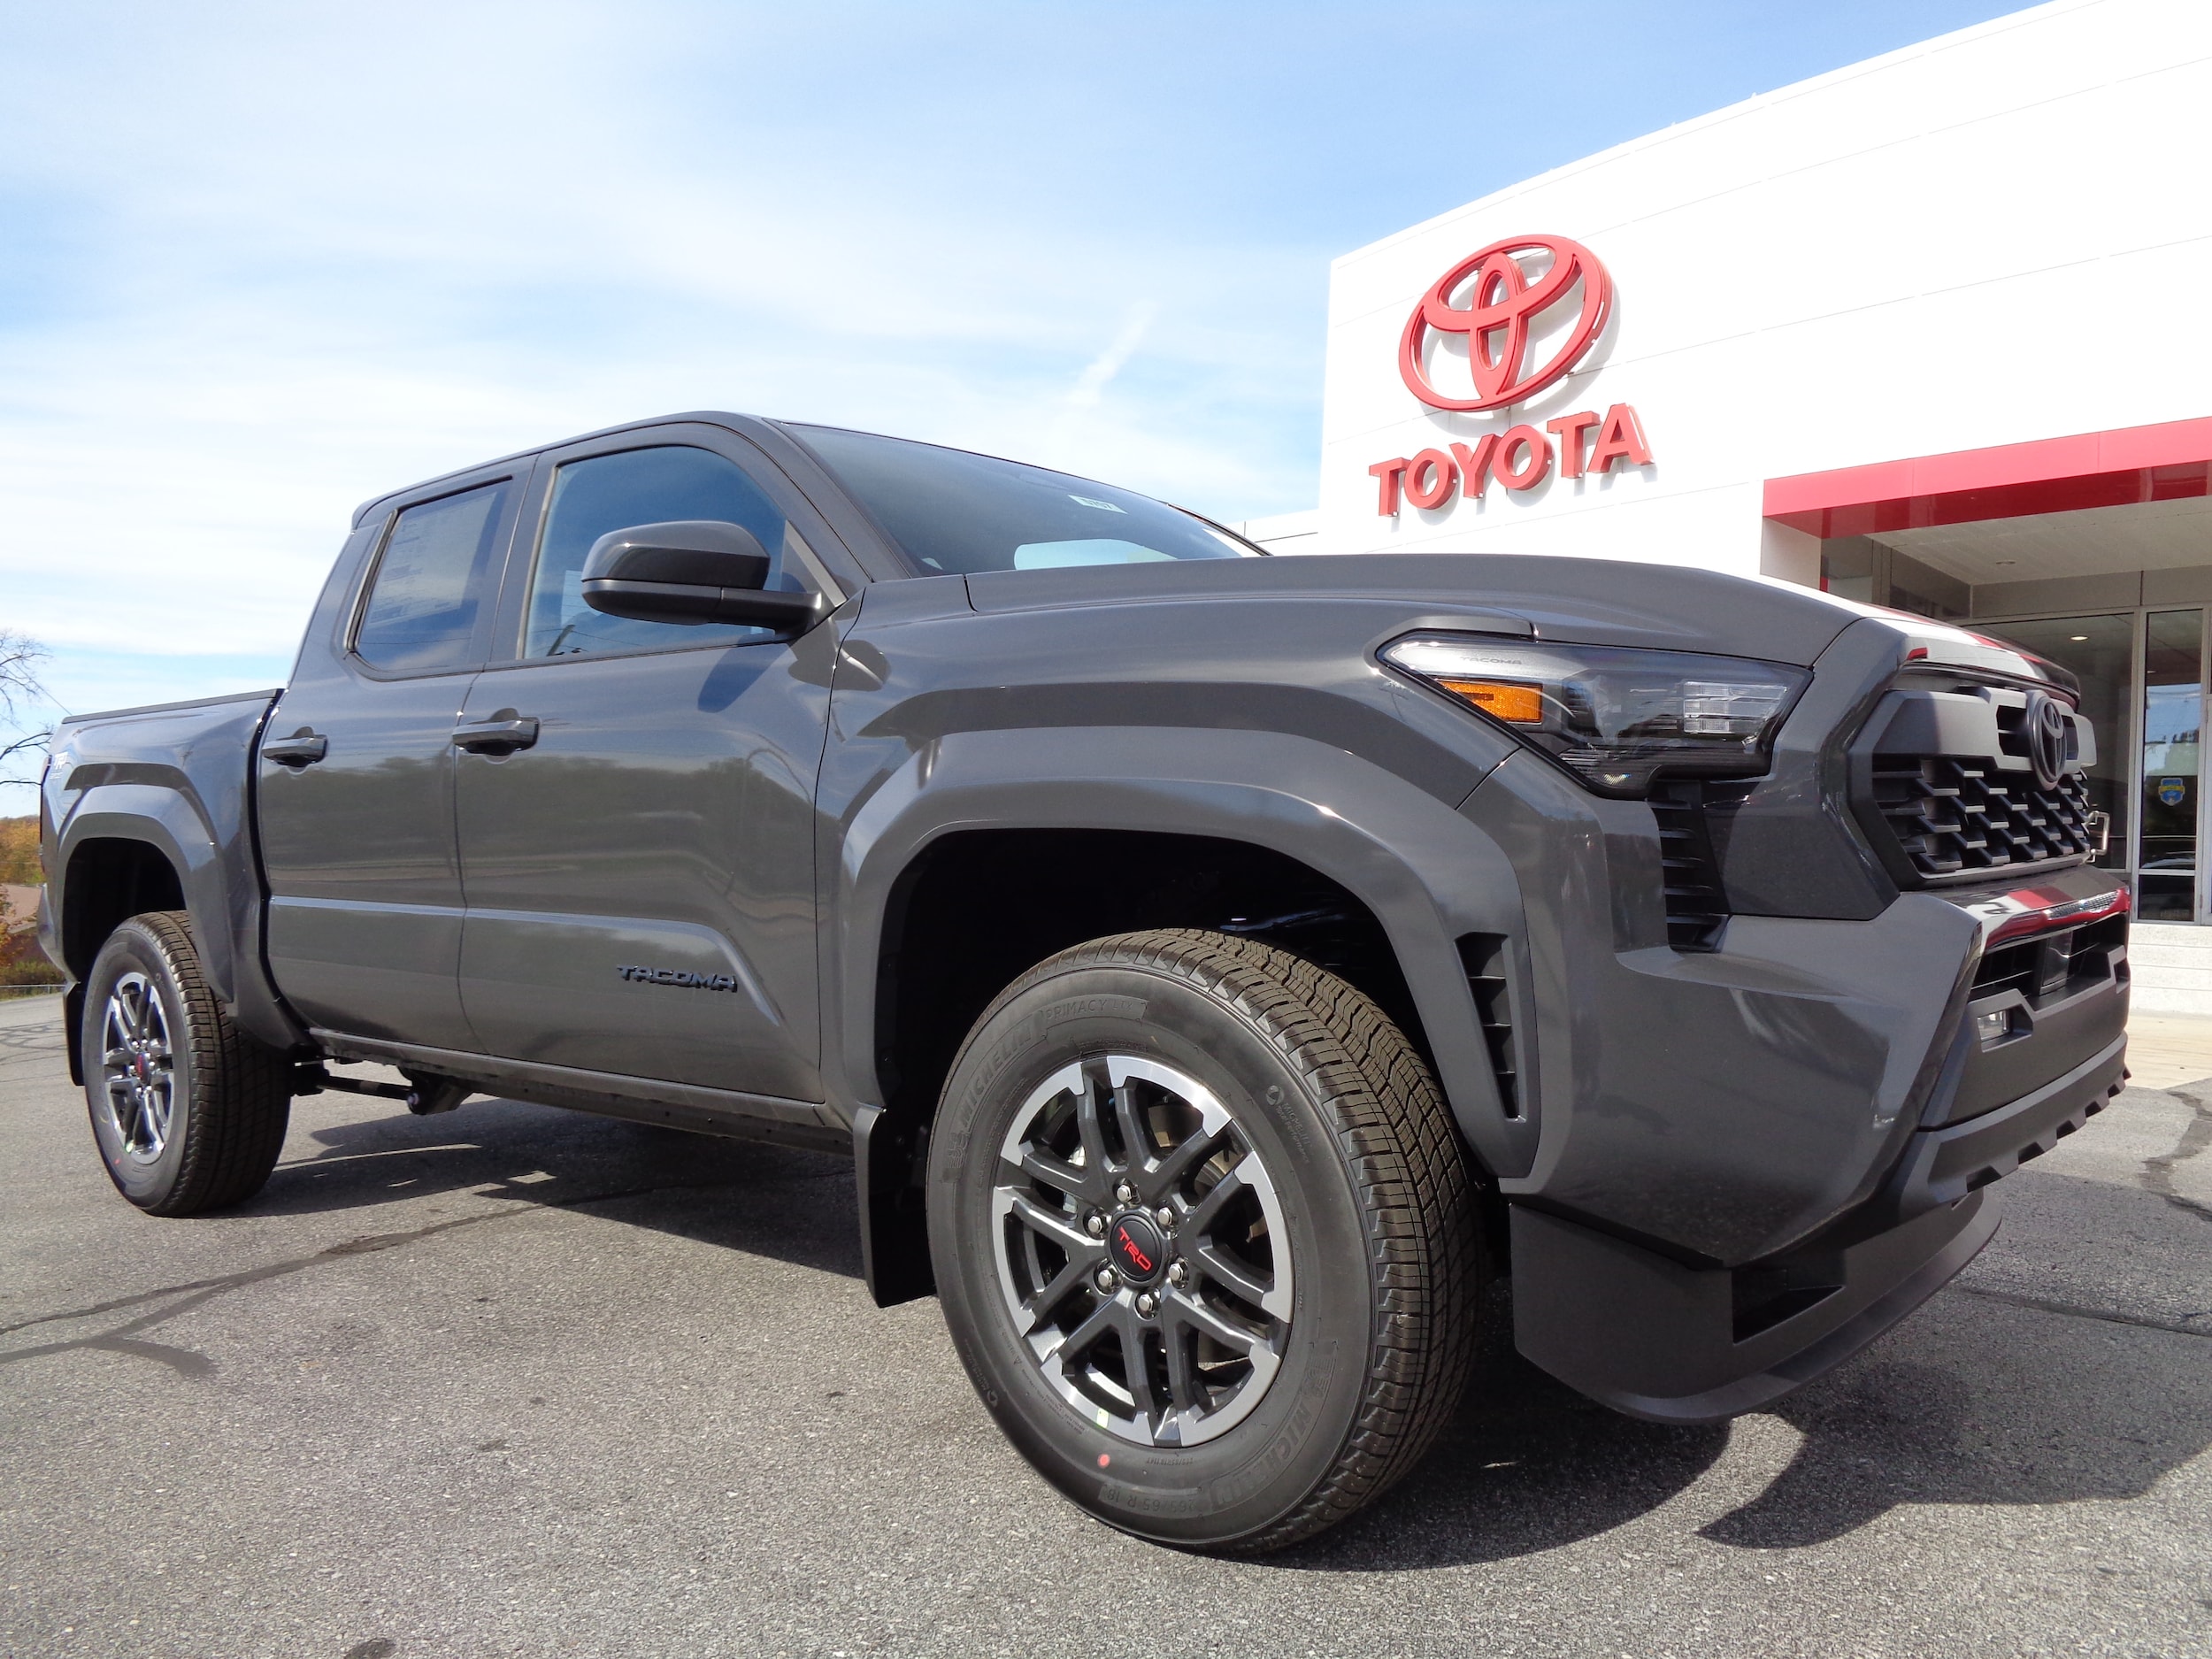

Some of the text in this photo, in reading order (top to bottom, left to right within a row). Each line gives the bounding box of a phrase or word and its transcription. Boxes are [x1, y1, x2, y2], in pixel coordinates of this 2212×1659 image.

[1369, 403, 1654, 517] TOYOTA
[1460, 656, 1522, 665] TACOMA
[617, 964, 738, 993] TACOMA
[958, 1023, 1033, 1127] MICHELIN
[1046, 1000, 1107, 1020] PRIMACY
[1118, 1226, 1152, 1271] TRD
